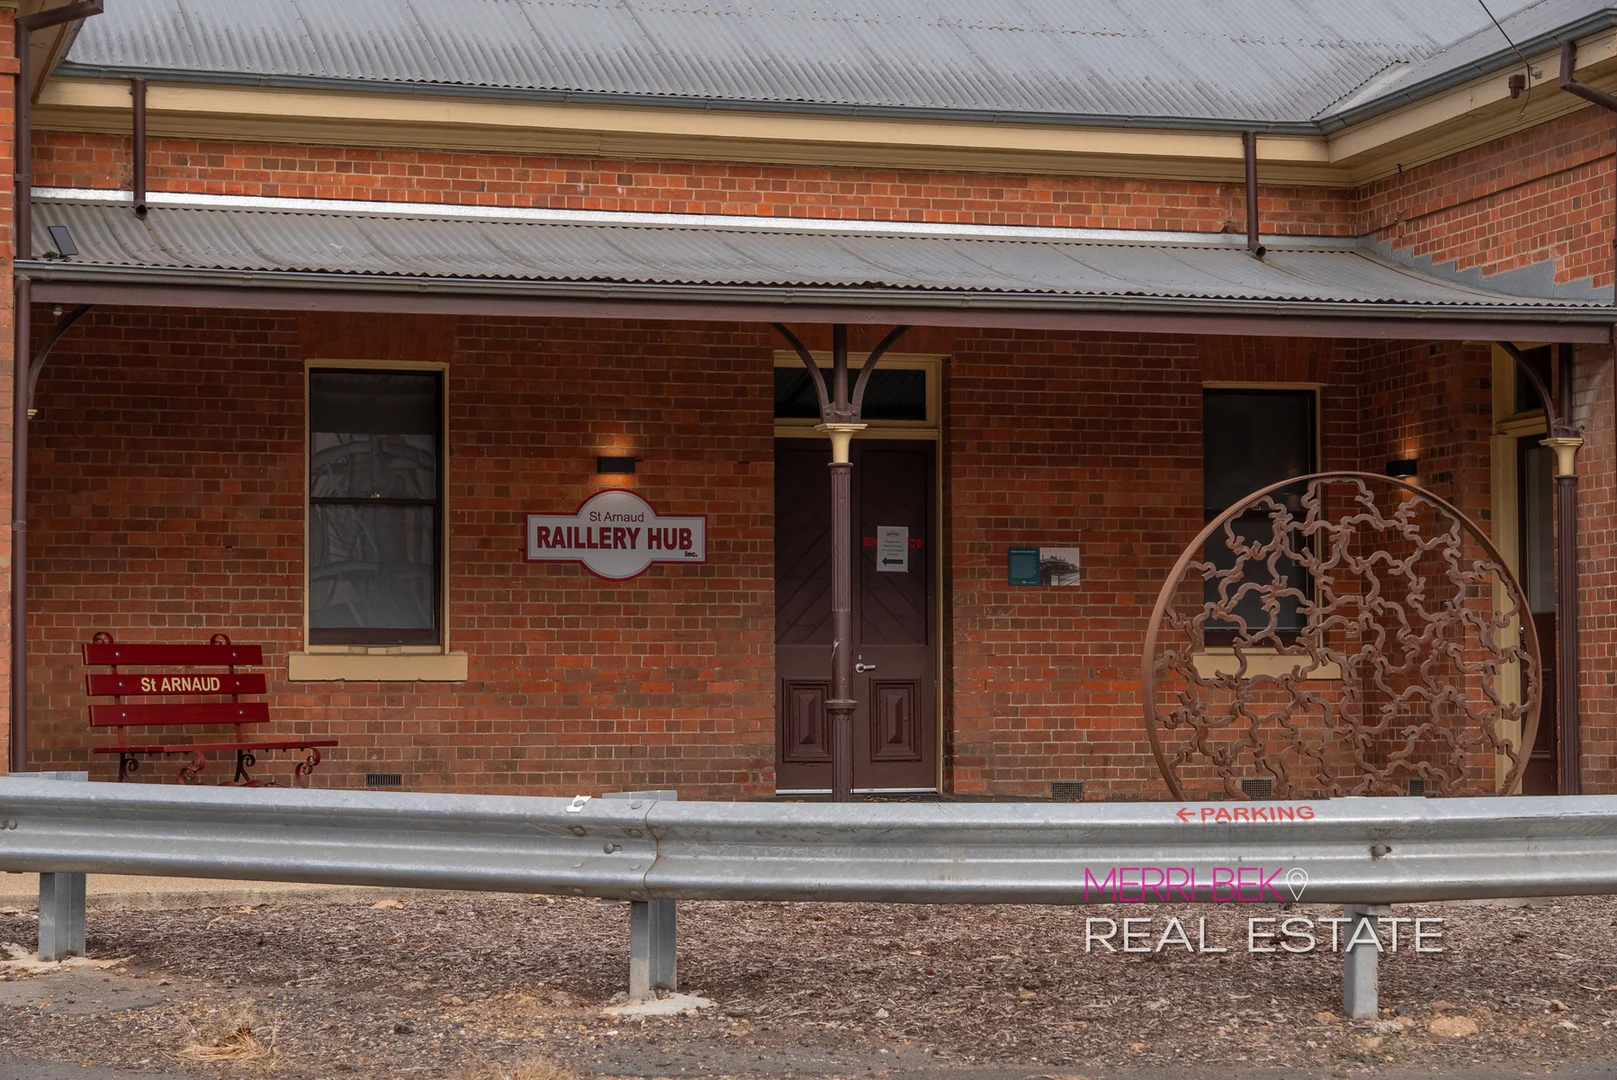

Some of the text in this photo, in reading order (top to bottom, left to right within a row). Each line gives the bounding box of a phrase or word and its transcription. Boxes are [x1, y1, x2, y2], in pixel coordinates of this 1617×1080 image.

[589, 511, 645, 523] St Arnaud
[536, 525, 693, 551] RAILLERY HUB
[684, 550, 698, 558] Inc.
[140, 677, 220, 692] St ARNAUD
[1200, 805, 1315, 821] PARKING
